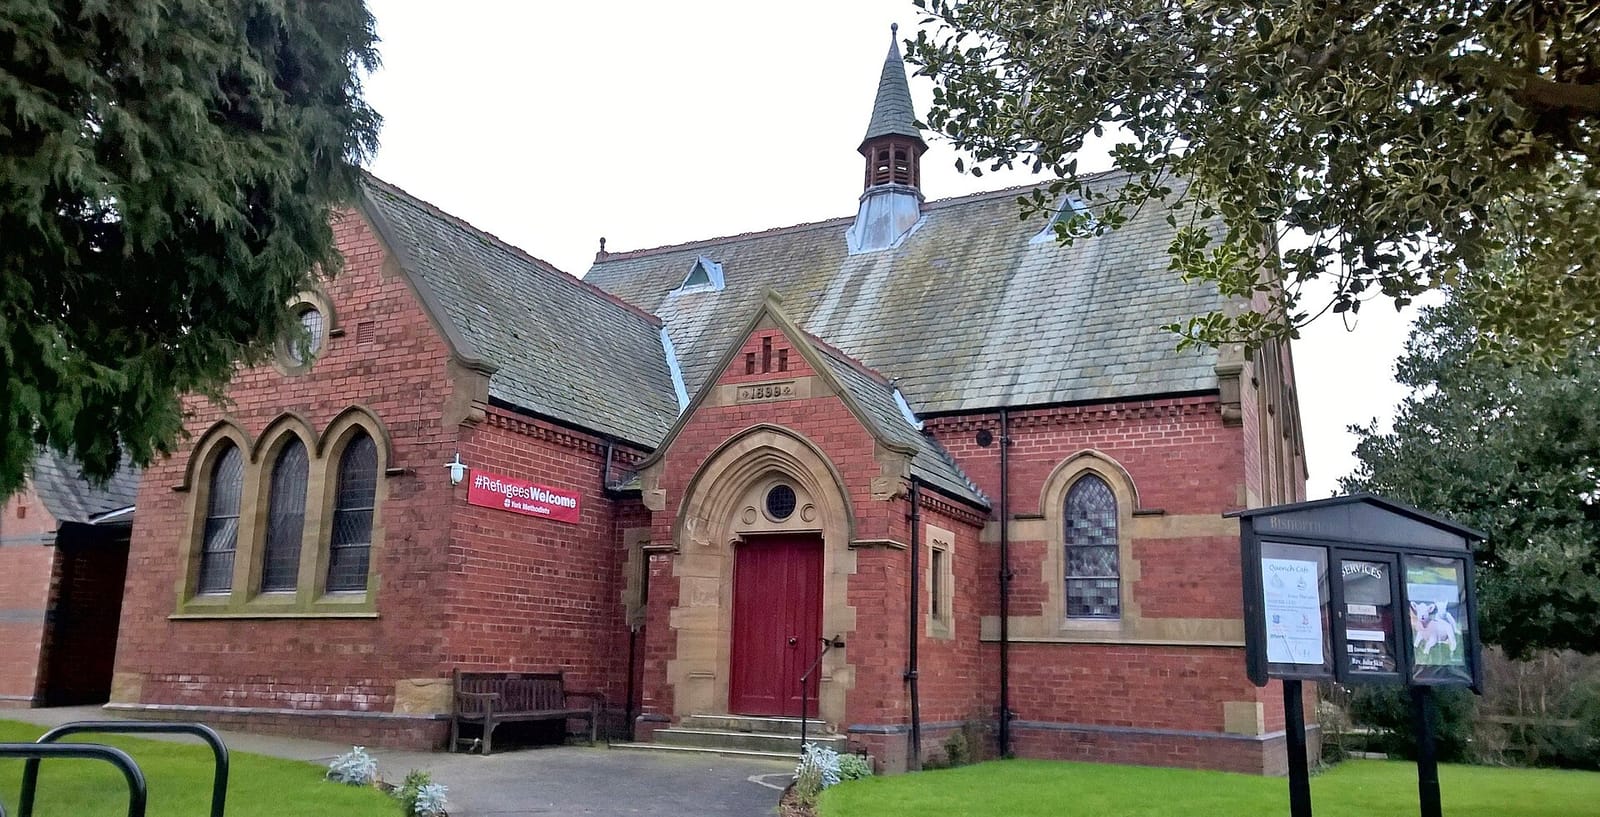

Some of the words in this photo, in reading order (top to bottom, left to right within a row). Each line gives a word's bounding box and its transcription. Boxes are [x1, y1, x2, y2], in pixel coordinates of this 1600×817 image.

[750, 386, 781, 399] 1899
[475, 475, 577, 508] #RefugeesWelcome
[1342, 563, 1383, 580] SERVICES
